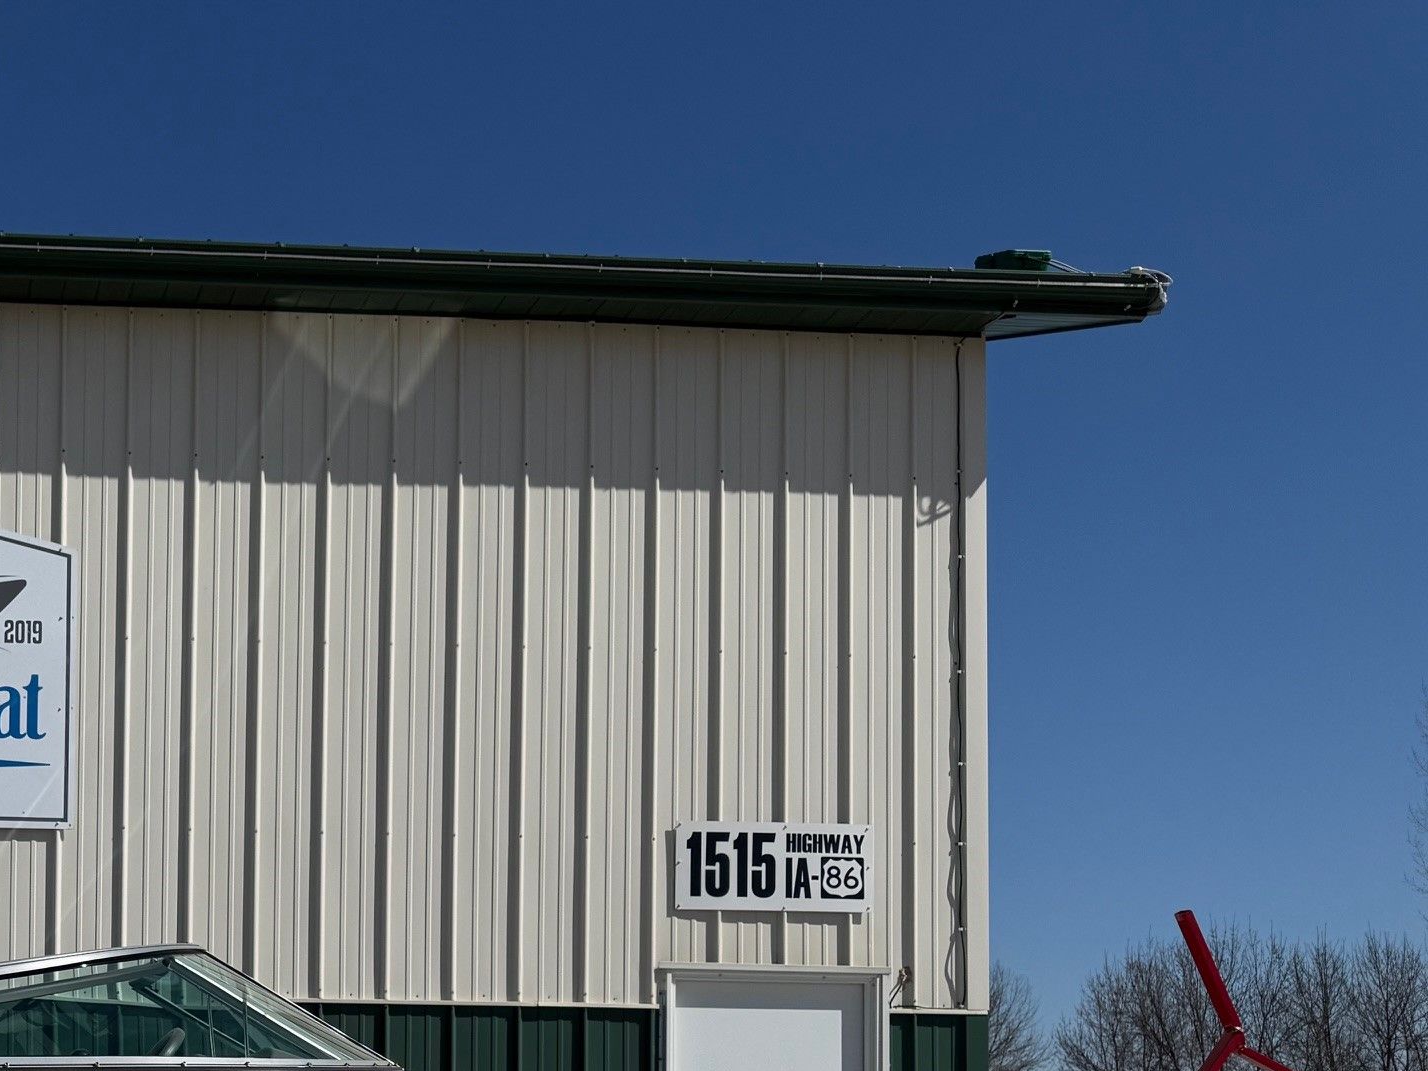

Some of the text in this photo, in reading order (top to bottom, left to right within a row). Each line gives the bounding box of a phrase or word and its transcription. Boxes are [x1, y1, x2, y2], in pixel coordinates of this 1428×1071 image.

[3, 619, 43, 645] 2019
[785, 832, 865, 855] HIGHWAY
[686, 831, 777, 898] 1515
